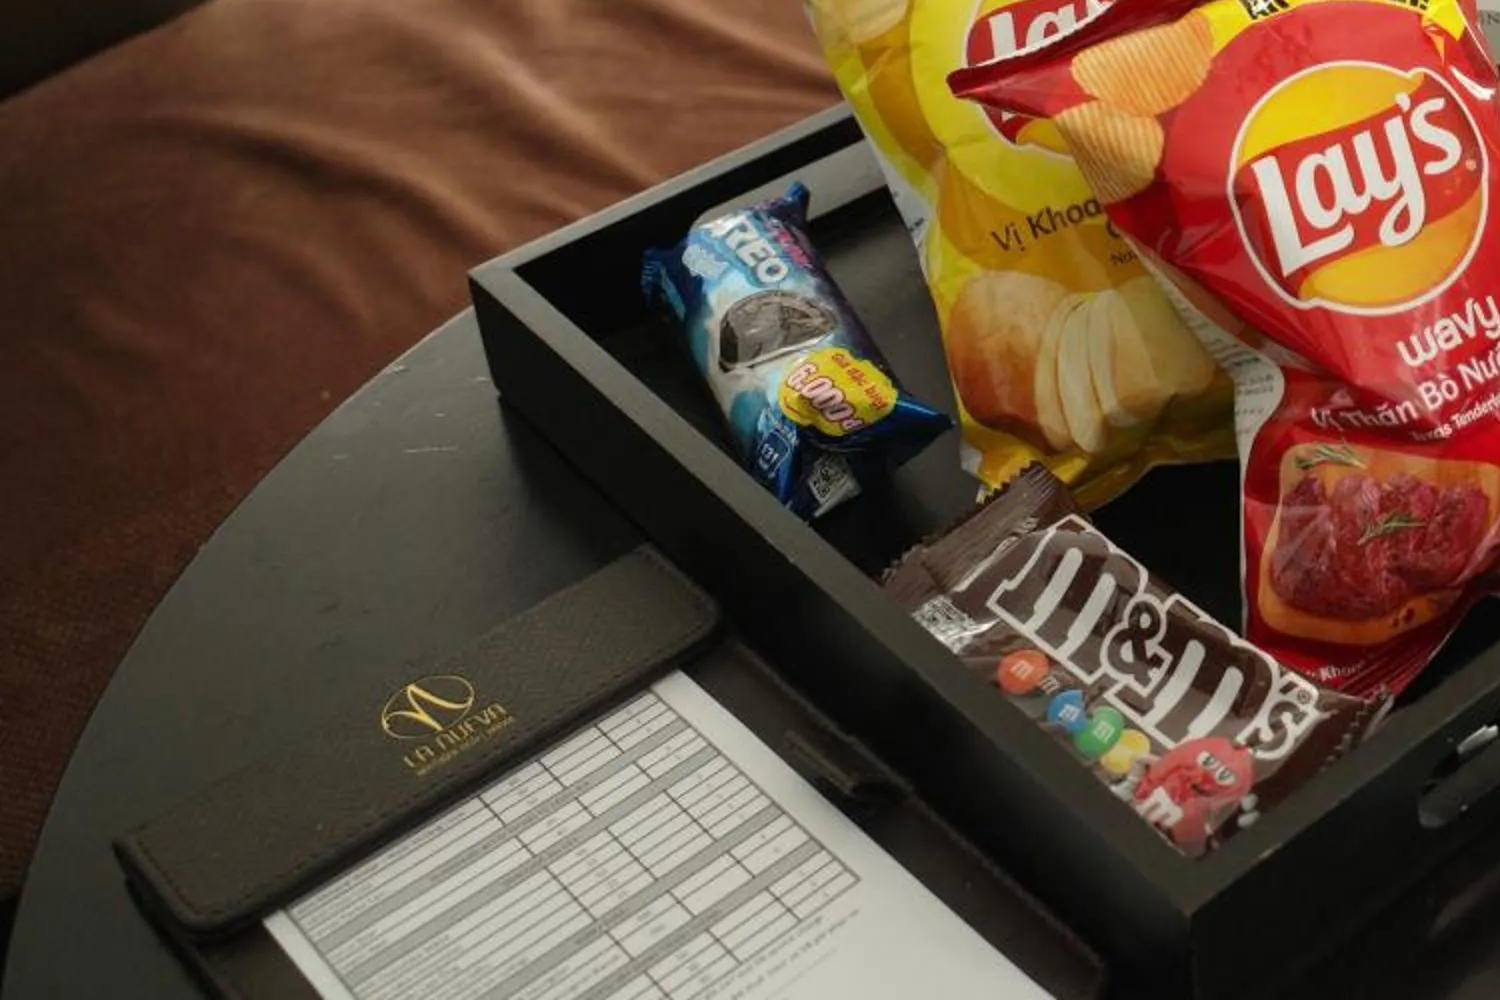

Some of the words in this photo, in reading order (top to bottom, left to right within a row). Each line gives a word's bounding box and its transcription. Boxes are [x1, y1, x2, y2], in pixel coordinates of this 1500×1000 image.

[1252, 93, 1463, 278] Lay's
[990, 221, 1026, 252] Vị
[1417, 373, 1459, 412] Bò
